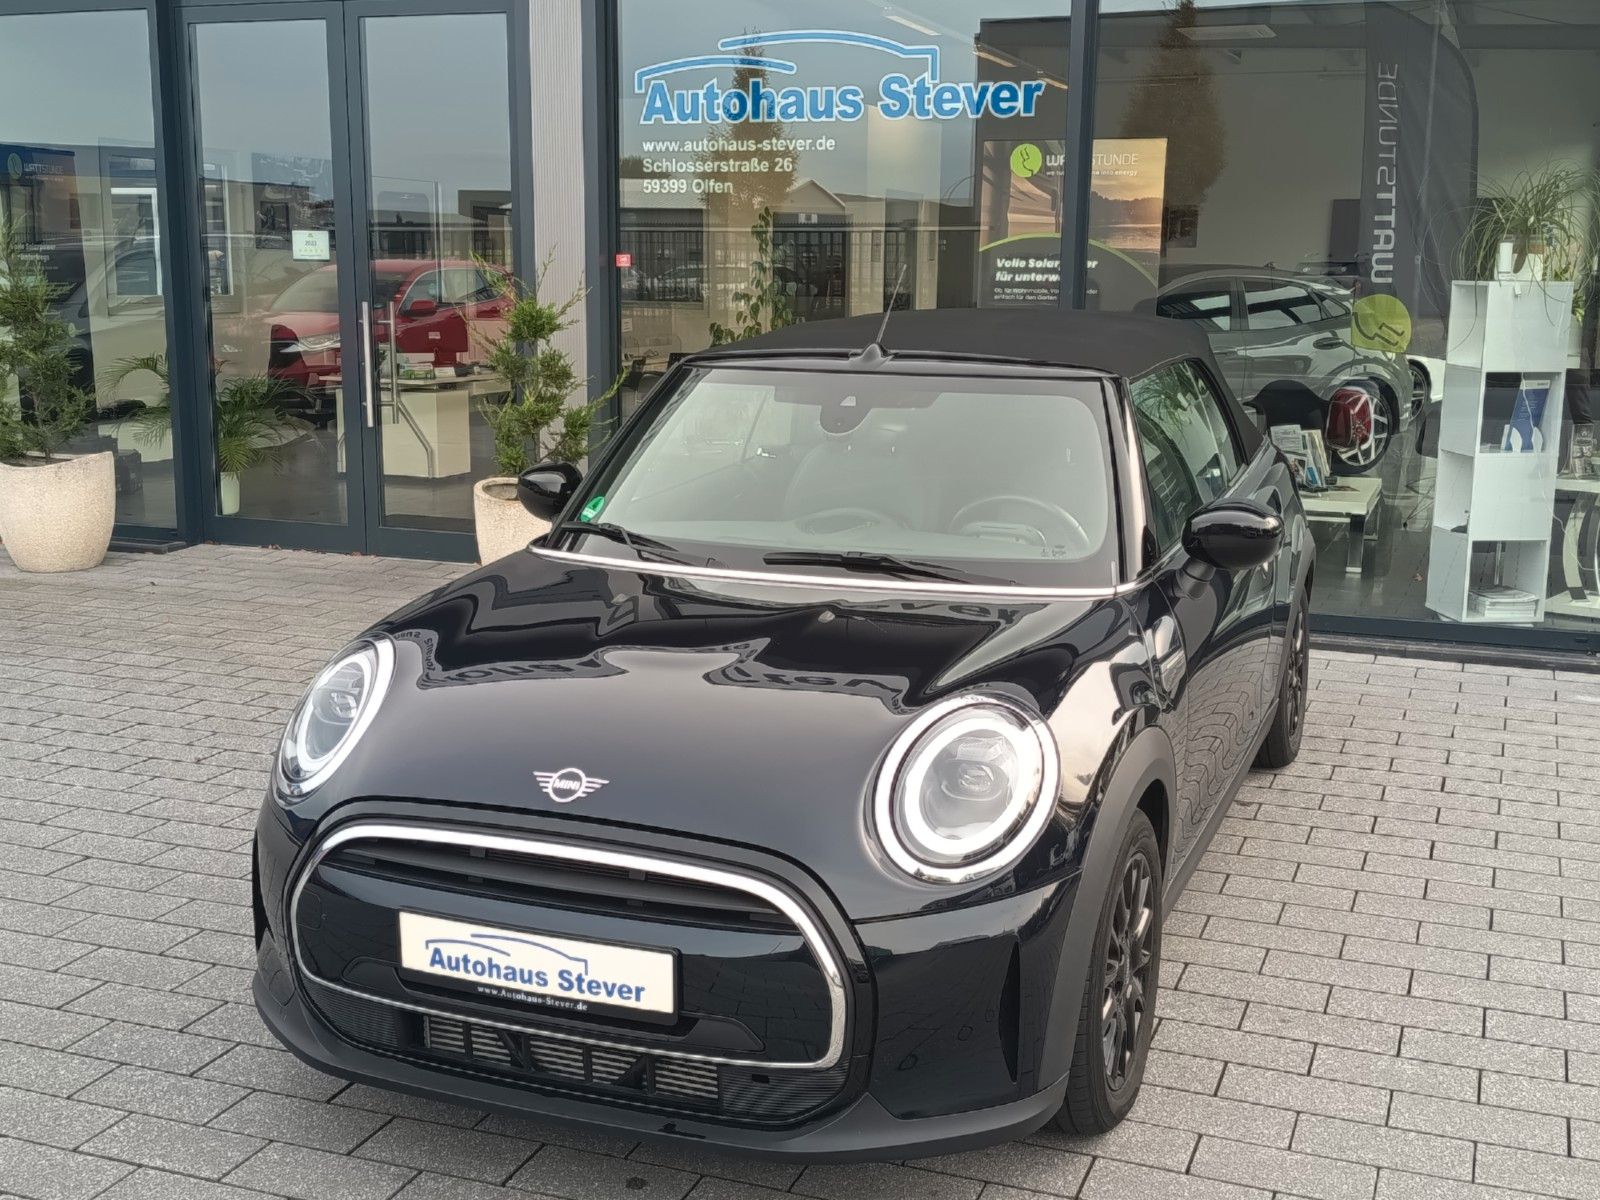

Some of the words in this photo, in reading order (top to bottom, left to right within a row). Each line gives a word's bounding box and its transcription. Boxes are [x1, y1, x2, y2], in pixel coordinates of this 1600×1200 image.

[640, 78, 864, 125] Autohaus
[878, 74, 1046, 121] Stever
[642, 137, 836, 153] www.autohaus-stever.de
[642, 157, 769, 174] Schlosserstraße
[774, 157, 793, 173] 26
[1114, 169, 1138, 177] energy
[642, 179, 687, 194] 59399
[692, 178, 734, 194] Olfen
[997, 258, 1026, 268] Volle
[995, 271, 1013, 281] für
[1014, 272, 1061, 282] unterw
[553, 778, 580, 791] MINI
[429, 947, 548, 988] Autohaus
[558, 969, 646, 1002] Stever
[477, 985, 588, 1012] www.Autohaus-Stever.de
